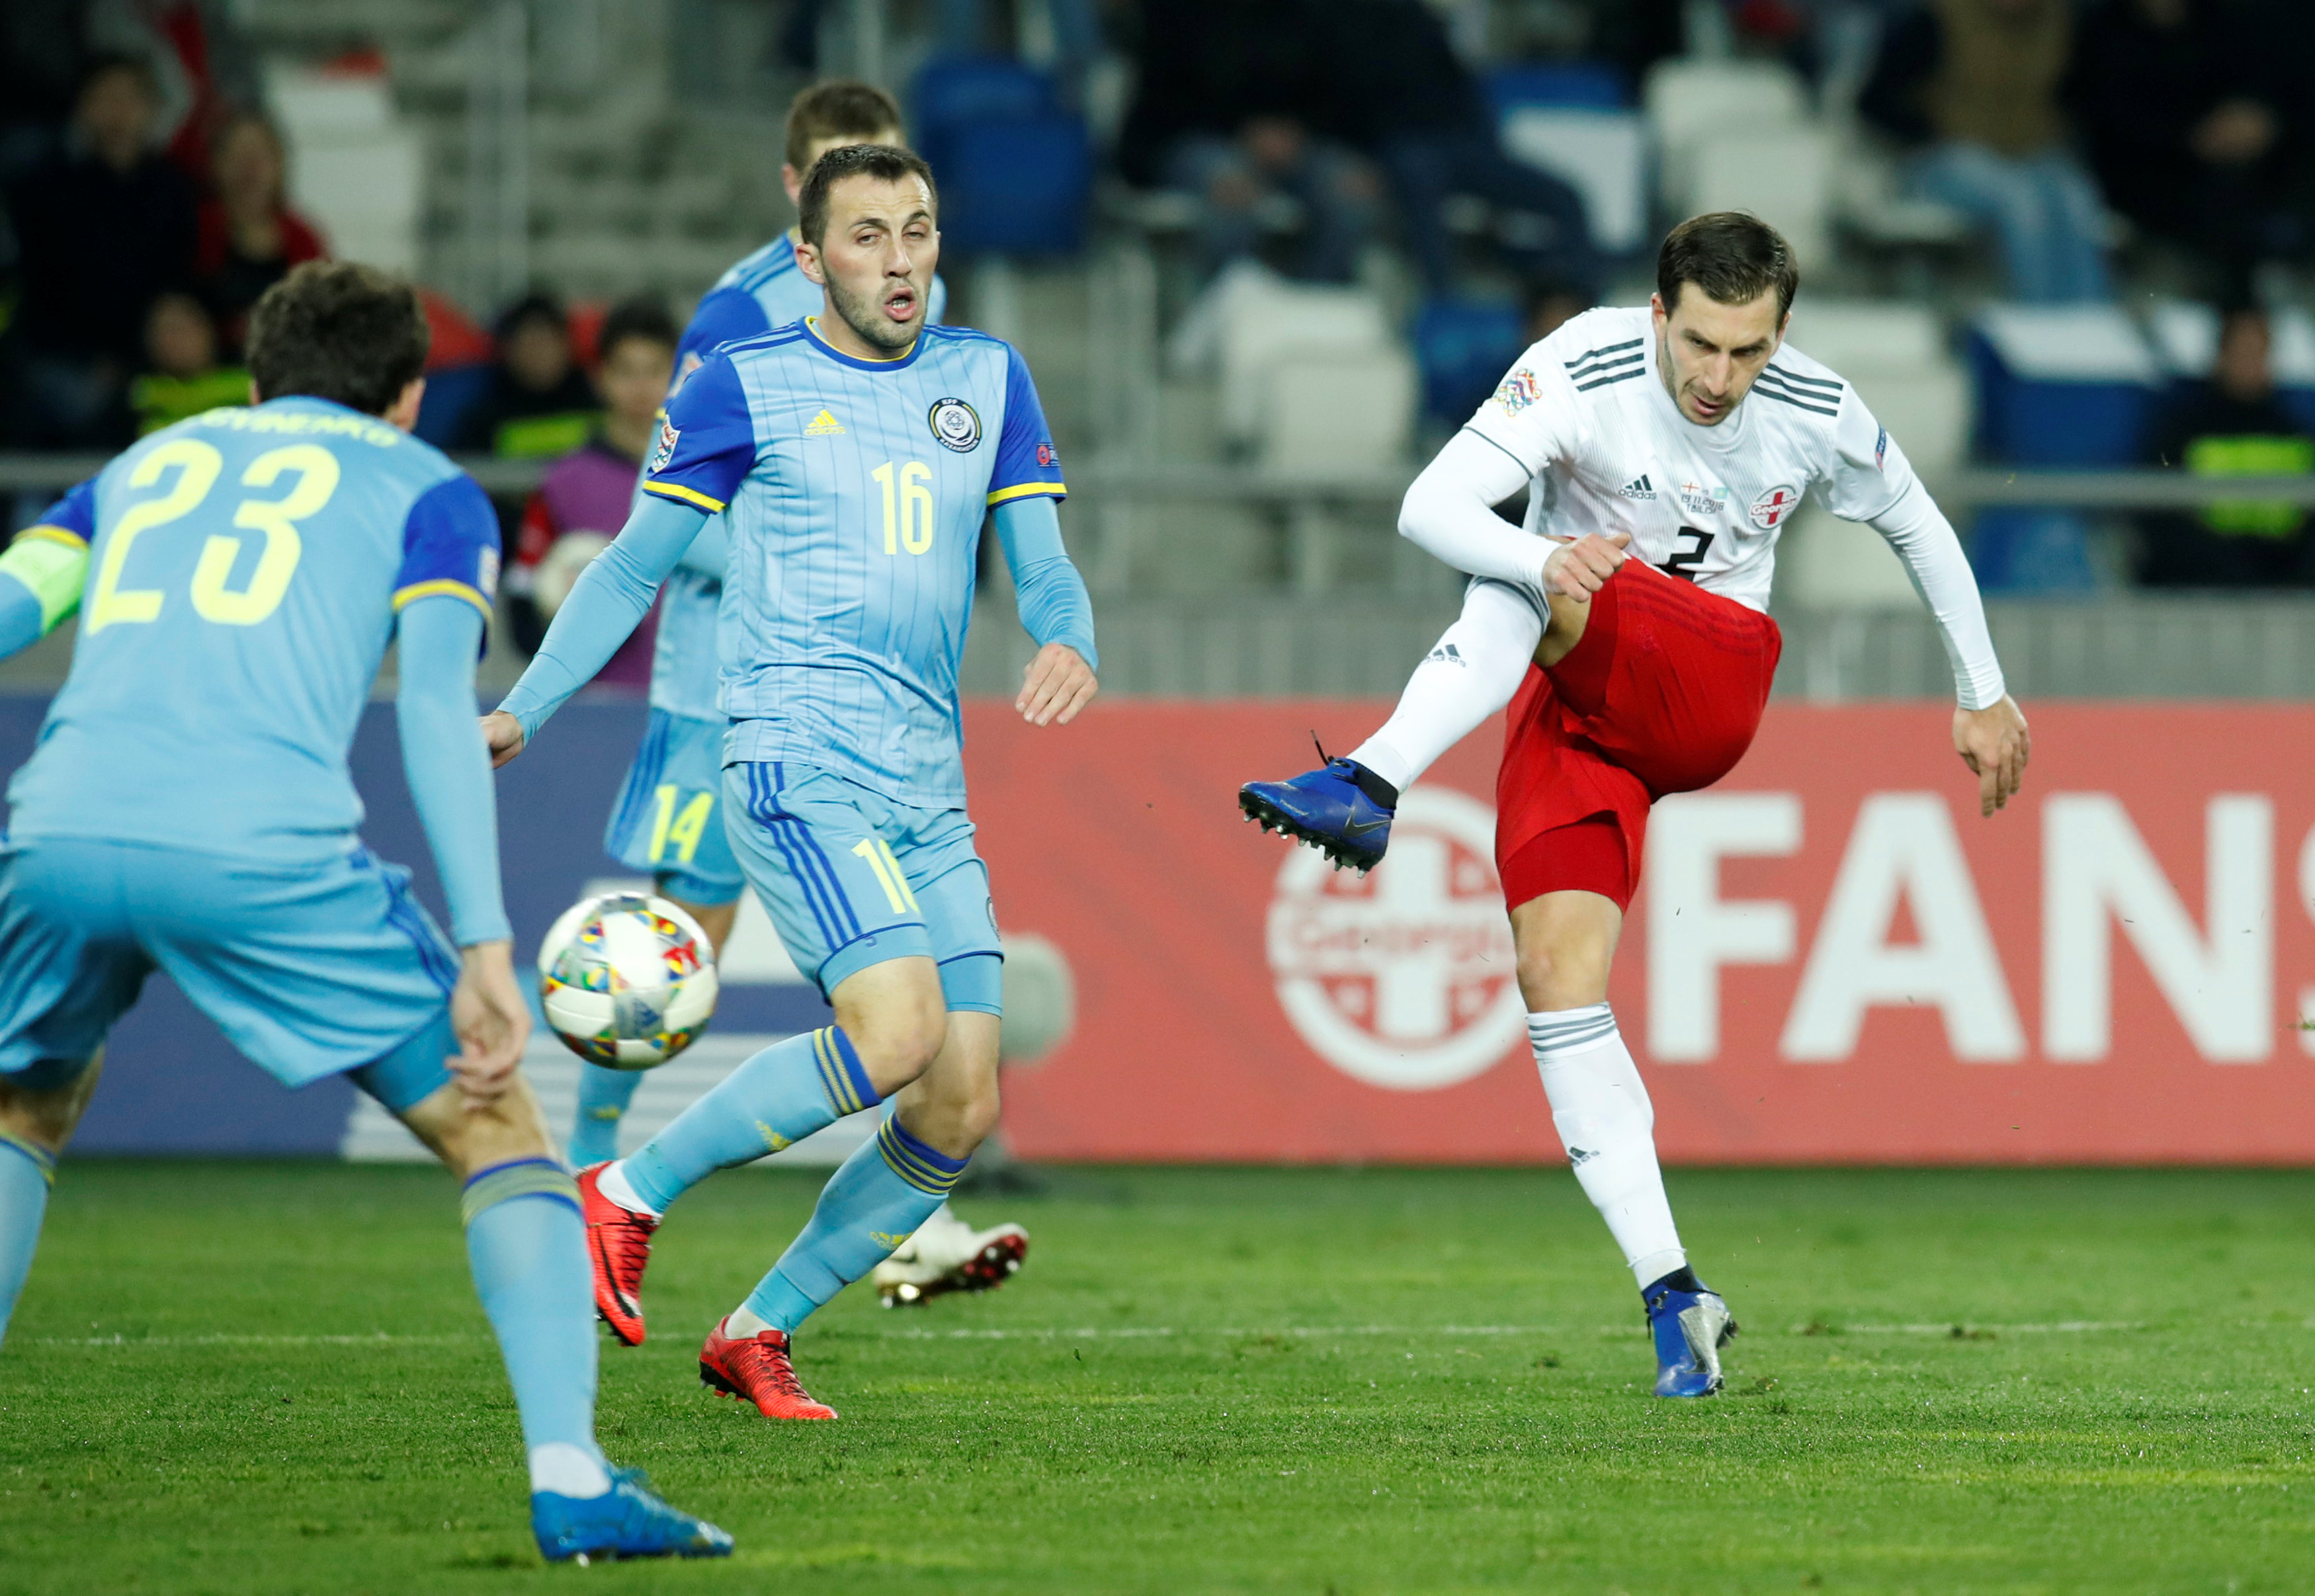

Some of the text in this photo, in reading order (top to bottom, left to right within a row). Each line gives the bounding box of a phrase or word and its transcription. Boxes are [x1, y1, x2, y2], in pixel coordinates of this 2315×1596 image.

[804, 426, 846, 437] adidas
[870, 460, 933, 556] 16
[1618, 488, 1657, 500] adidas
[85, 438, 341, 638] 23
[1653, 526, 1714, 582] 2
[649, 784, 713, 863] 14
